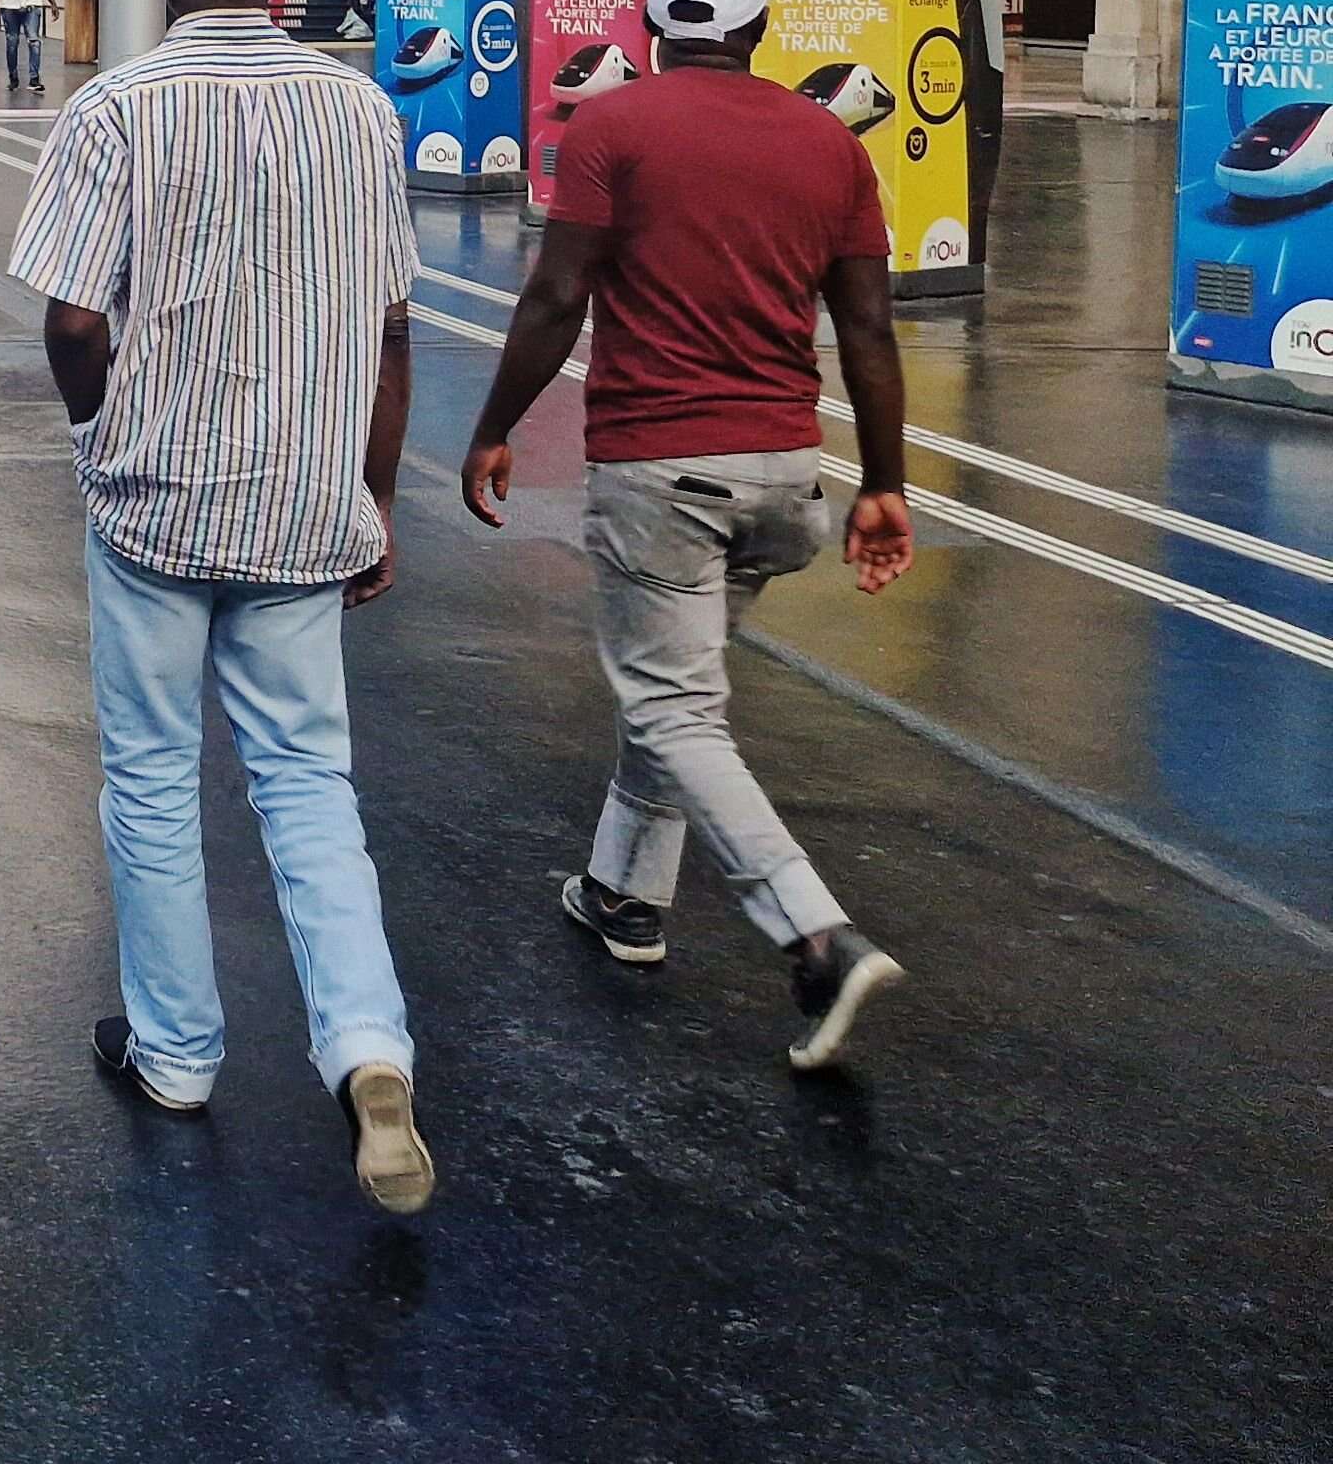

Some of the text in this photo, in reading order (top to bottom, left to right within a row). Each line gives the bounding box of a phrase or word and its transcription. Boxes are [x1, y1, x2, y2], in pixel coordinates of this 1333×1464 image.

[392, 6, 438, 20] TRAIN.
[600, 9, 615, 19] DE
[783, 6, 889, 22] ET L'EUROPE
[1216, 8, 1240, 24] LA
[550, 18, 608, 36] TRAIN.
[843, 23, 862, 34] DE
[481, 32, 511, 50] 3 min
[779, 34, 853, 53] TRAIN.
[1226, 29, 1249, 44] ET
[920, 71, 955, 94] 3 min
[1217, 62, 1323, 90] TRAIN.
